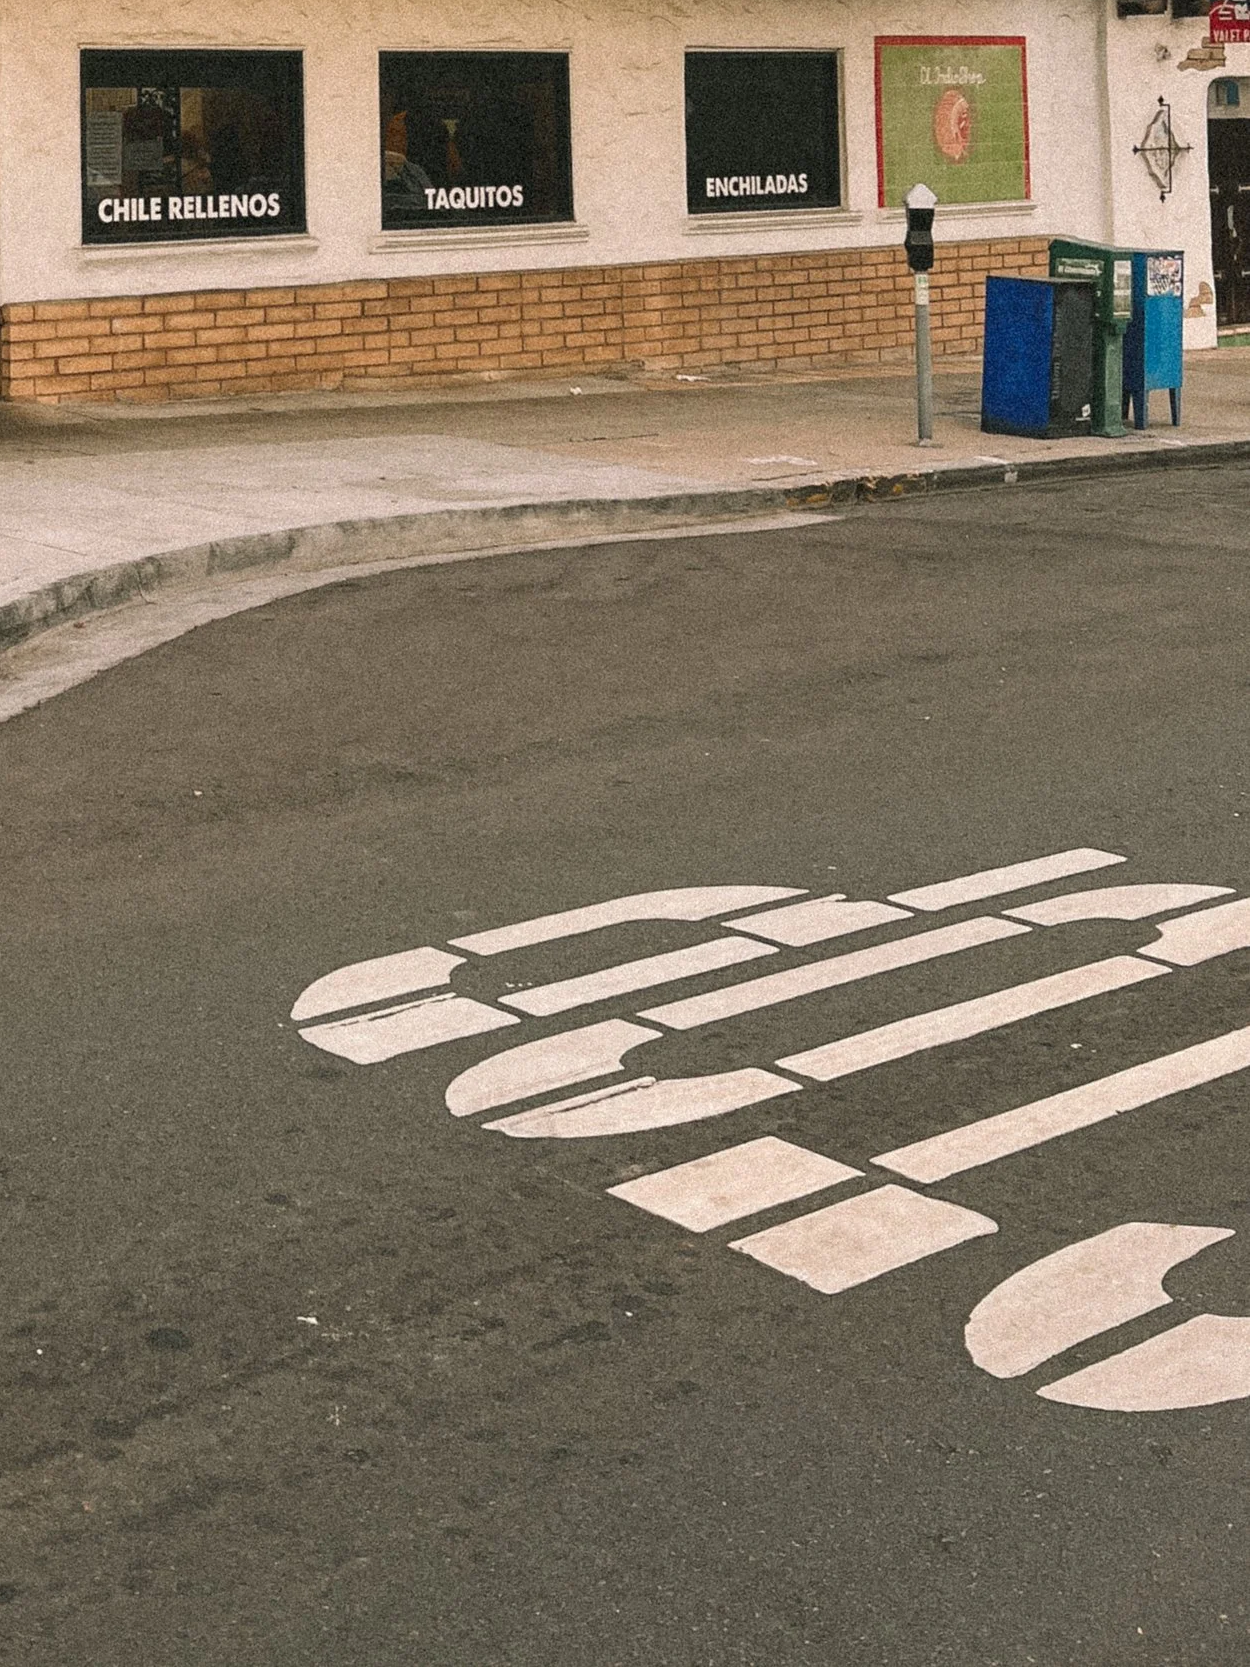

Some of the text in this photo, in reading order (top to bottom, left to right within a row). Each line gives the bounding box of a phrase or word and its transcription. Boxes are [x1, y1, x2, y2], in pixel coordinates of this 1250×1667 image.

[425, 185, 524, 210] TAQUITOS
[706, 174, 808, 197] ENCHILADAS
[98, 193, 280, 223] CHILE RELLENOS
